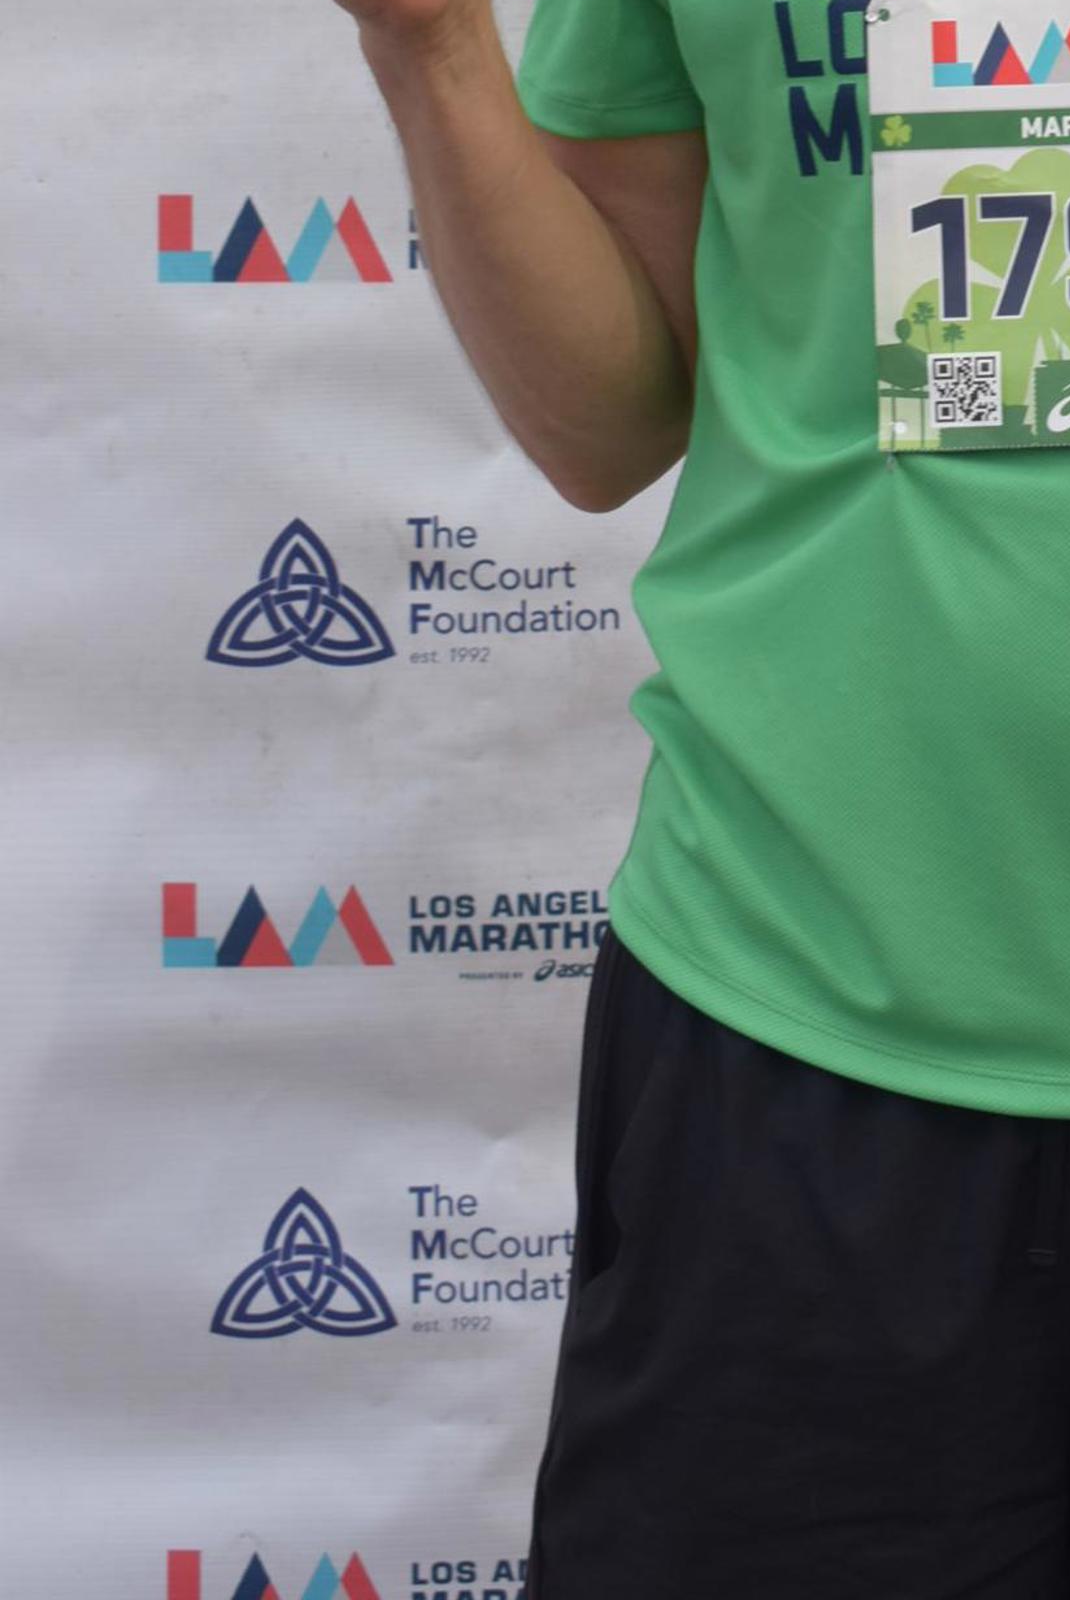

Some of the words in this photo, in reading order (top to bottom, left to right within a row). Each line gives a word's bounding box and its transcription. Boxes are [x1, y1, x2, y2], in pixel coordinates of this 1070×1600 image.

[407, 516, 477, 549] The
[409, 559, 575, 591] McCourt
[410, 600, 619, 634] Foundation
[450, 647, 490, 663] 1992
[410, 895, 475, 919] LOS
[491, 891, 608, 917] ANGEL
[410, 921, 609, 952] MARATH
[408, 1184, 477, 1217] The
[411, 1227, 575, 1260] McCourt
[412, 1268, 571, 1304] Foundat
[451, 1316, 490, 1332] 1992
[412, 1561, 476, 1585] LOS
